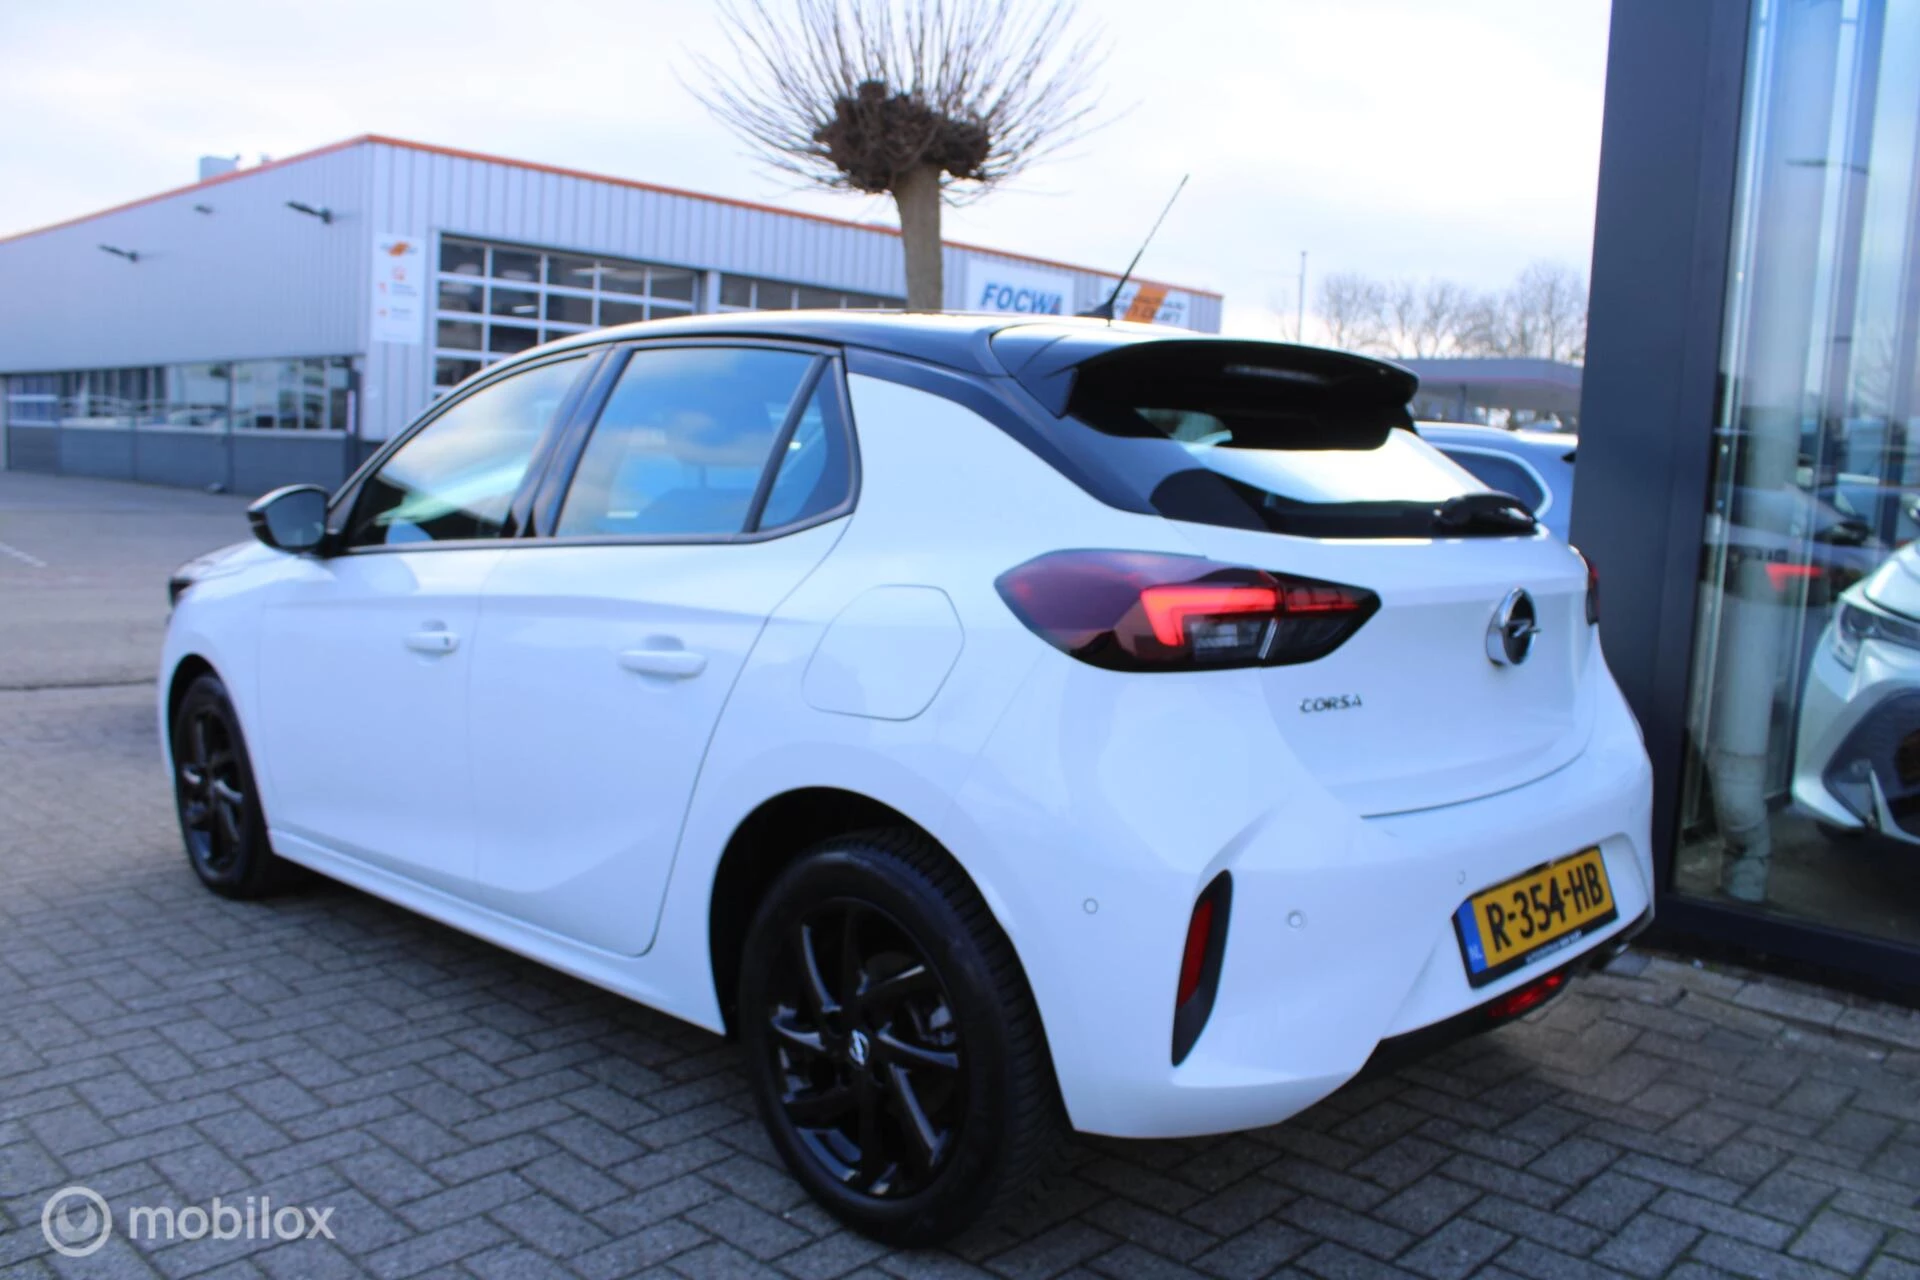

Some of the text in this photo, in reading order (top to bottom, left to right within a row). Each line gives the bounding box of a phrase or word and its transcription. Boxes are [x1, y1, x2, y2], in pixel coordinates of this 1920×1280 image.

[982, 283, 1062, 316] FOCWA
[1300, 694, 1362, 713] CORSA
[1486, 862, 1604, 952] R-354-HB
